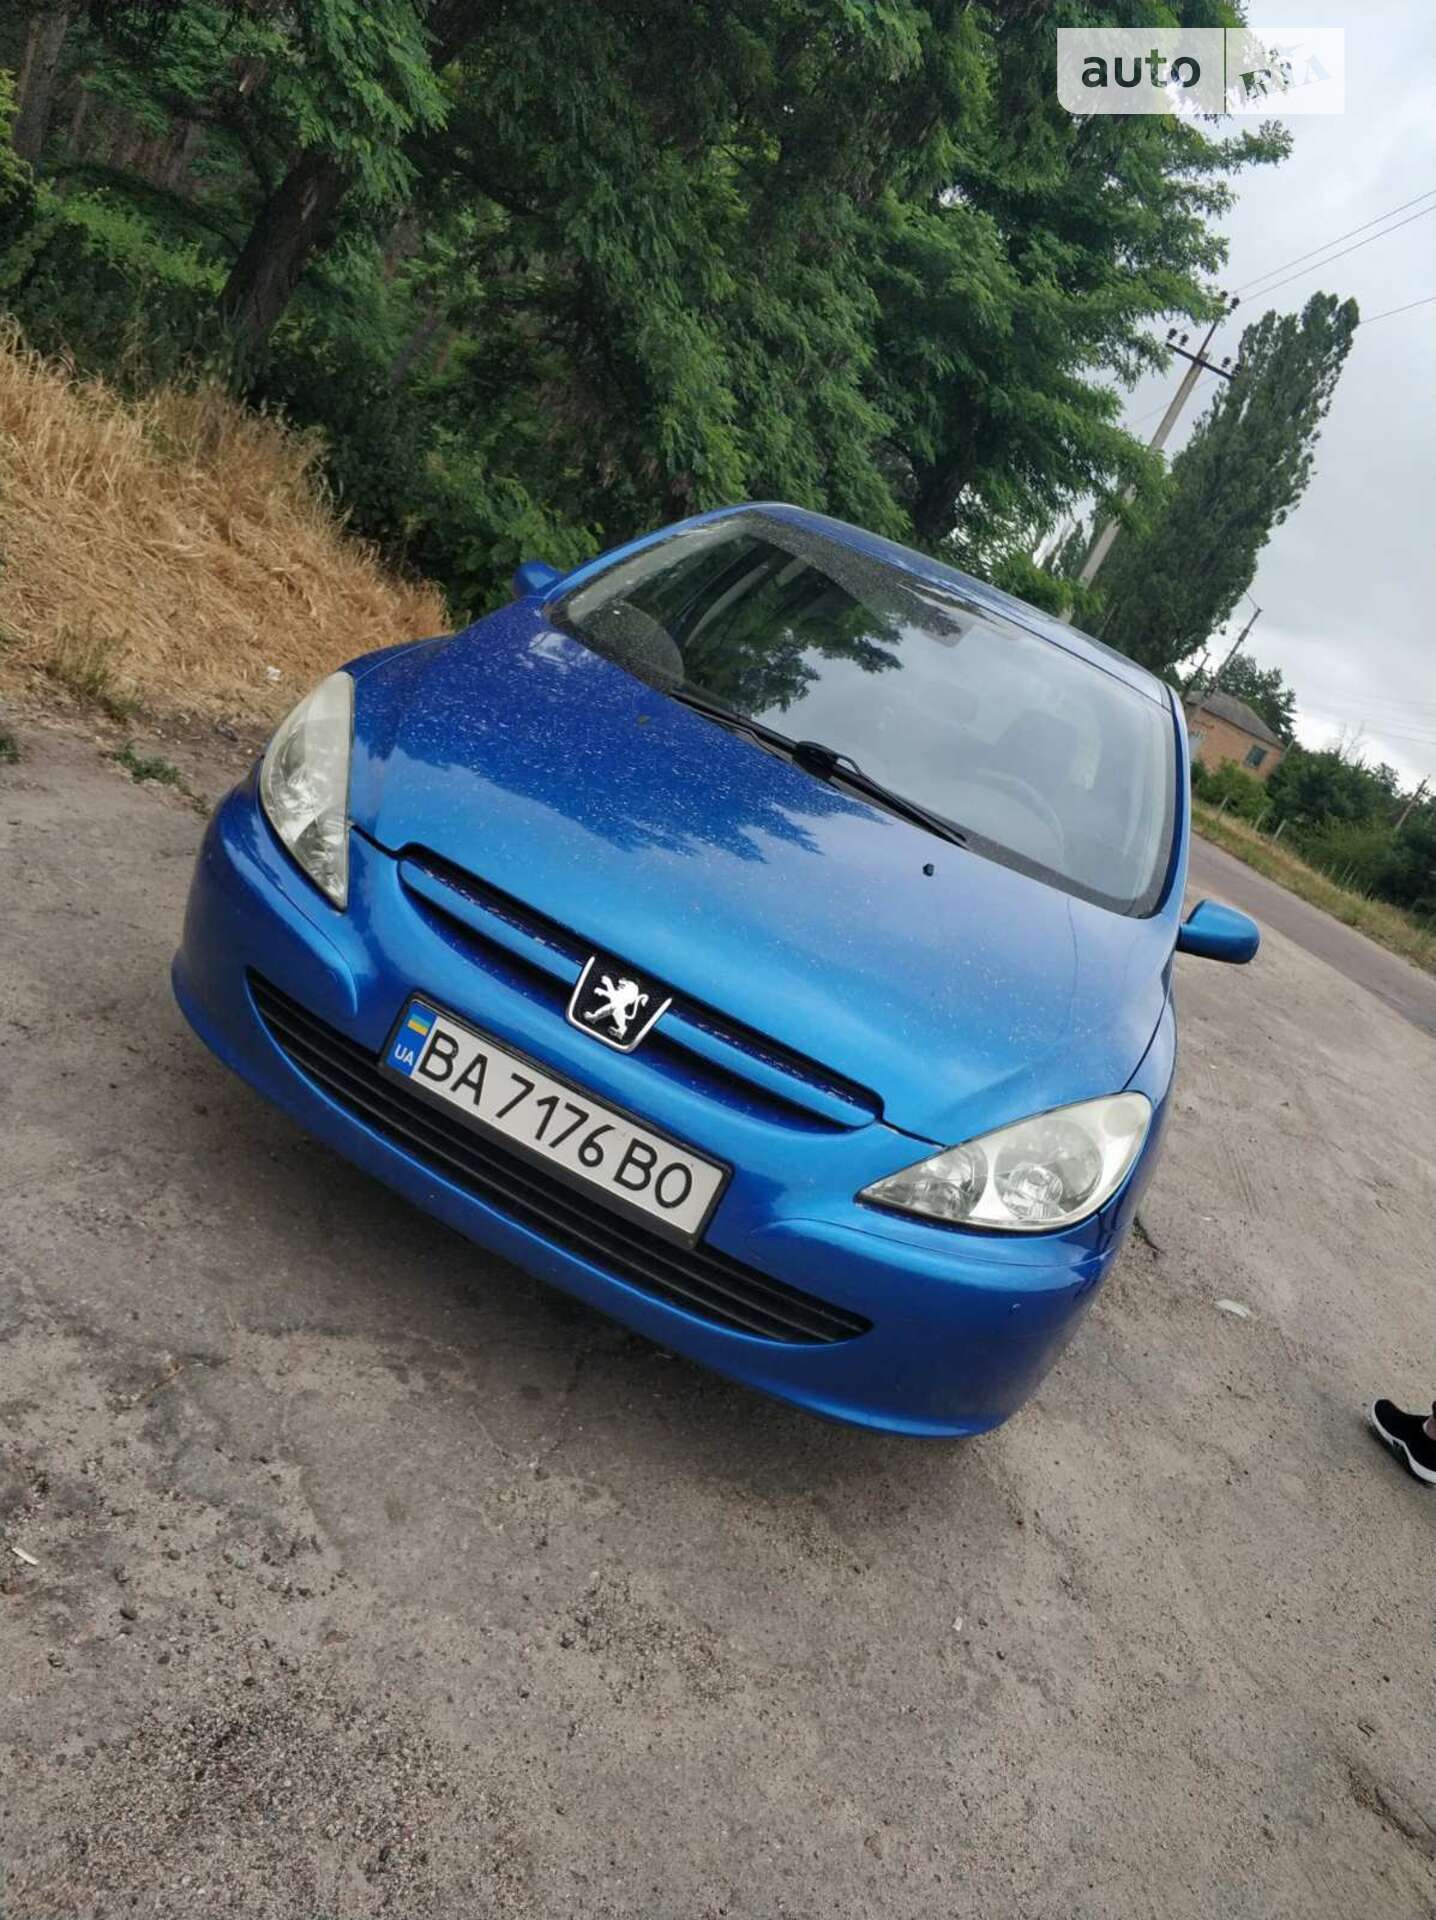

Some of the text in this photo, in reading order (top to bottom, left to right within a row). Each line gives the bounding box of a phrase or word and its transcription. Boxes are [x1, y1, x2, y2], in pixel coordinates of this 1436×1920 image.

[394, 1043, 414, 1067] UA
[418, 1029, 693, 1209] BA 7176 BO
